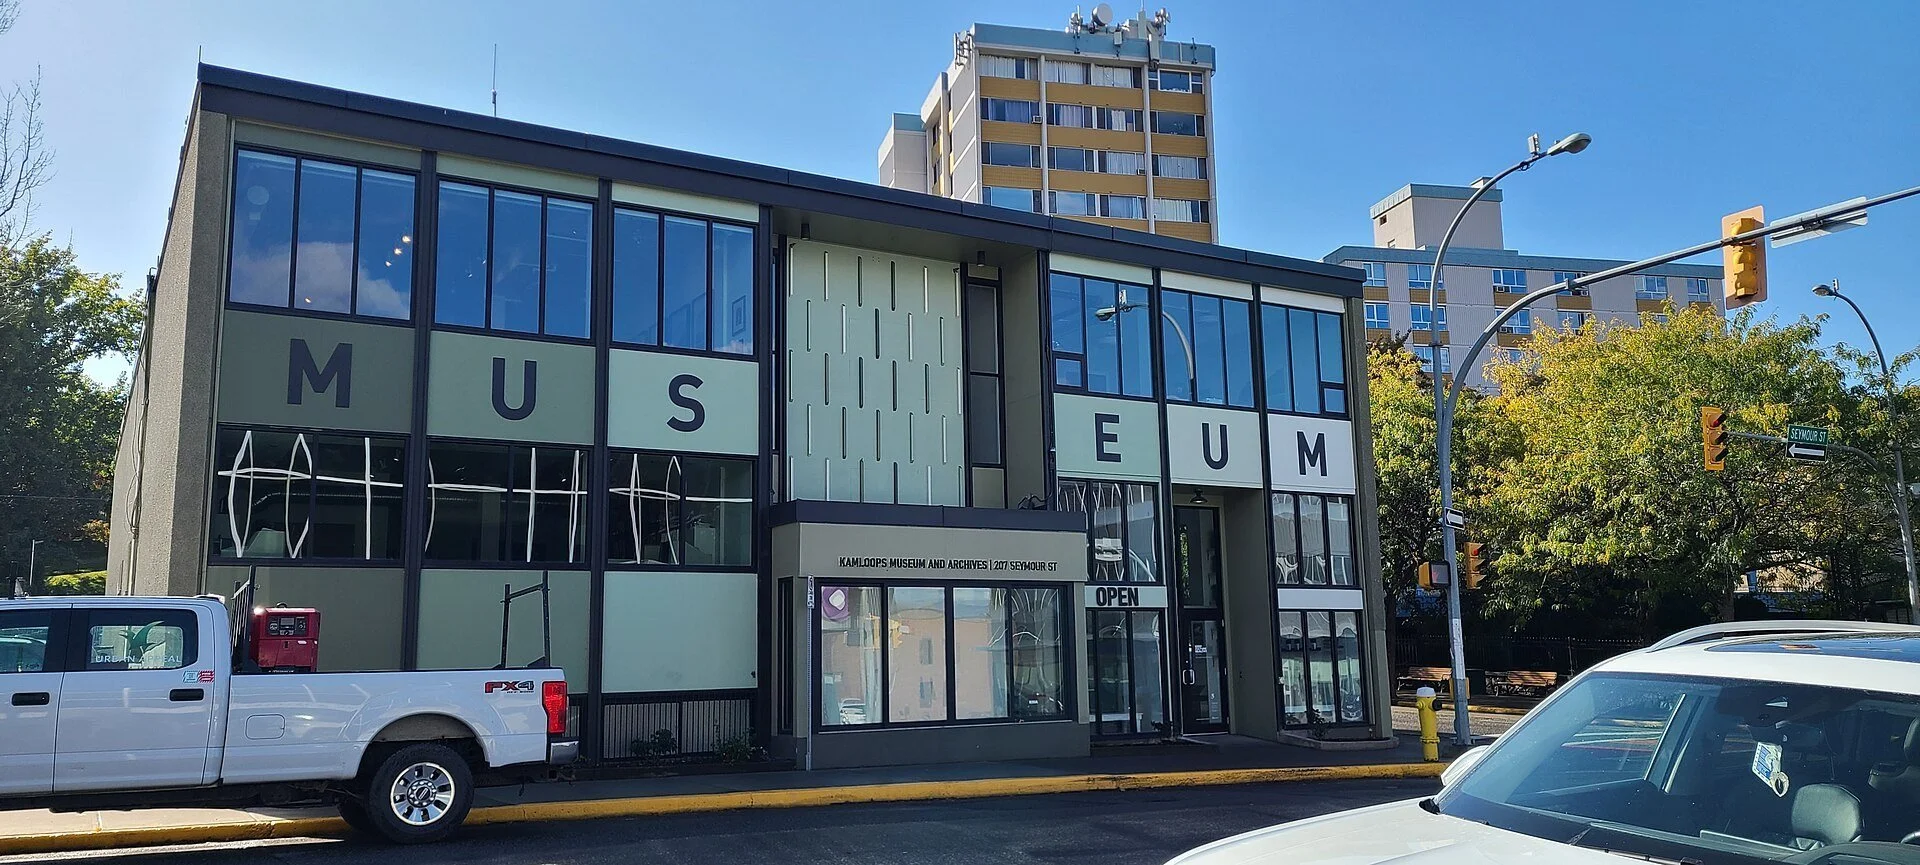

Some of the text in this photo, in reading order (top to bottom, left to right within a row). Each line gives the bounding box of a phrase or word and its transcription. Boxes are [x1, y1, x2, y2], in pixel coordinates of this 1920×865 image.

[1790, 428, 1827, 442] SEYMOUR ST
[839, 556, 888, 568] KAMLOOPS
[889, 558, 926, 569] MUSEUM
[927, 559, 946, 569] AND
[947, 559, 988, 570] ARCHIVES
[993, 560, 1008, 571] 207
[1009, 560, 1046, 571] SEYMOUR
[1047, 561, 1058, 572] ST
[1096, 587, 1139, 606] OPEN
[95, 655, 182, 663] URBAN APPEAL
[484, 680, 535, 693] FX4
